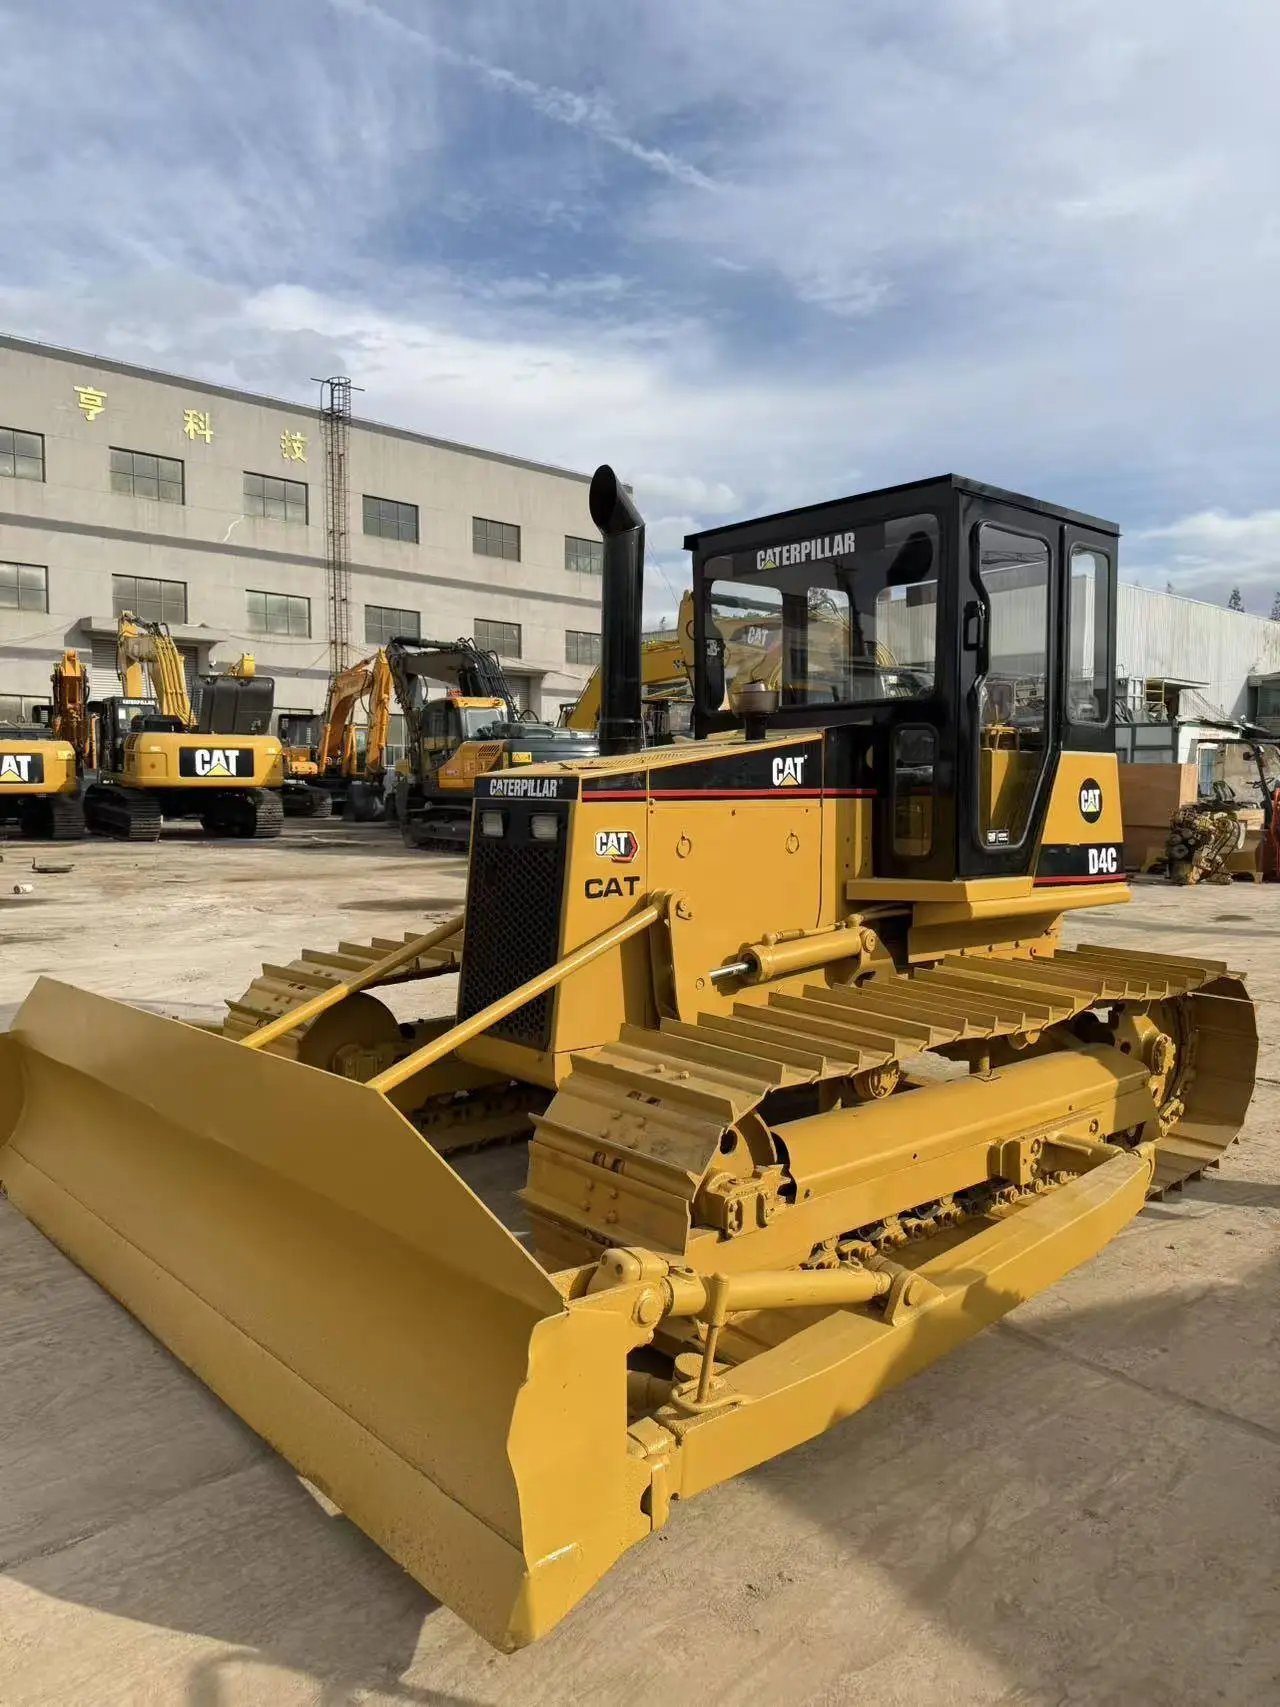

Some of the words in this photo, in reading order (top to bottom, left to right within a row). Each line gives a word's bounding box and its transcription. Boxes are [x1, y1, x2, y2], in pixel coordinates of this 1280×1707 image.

[756, 532, 856, 571] CATERPILLAR
[747, 626, 769, 647] CAT
[194, 749, 239, 776] CAT
[772, 757, 805, 787] CAT
[489, 778, 558, 798] CATERPILLAR
[1080, 789, 1101, 813] CAT
[595, 831, 628, 856] CAT
[1088, 847, 1118, 875] D4C
[584, 876, 640, 899] CAT
